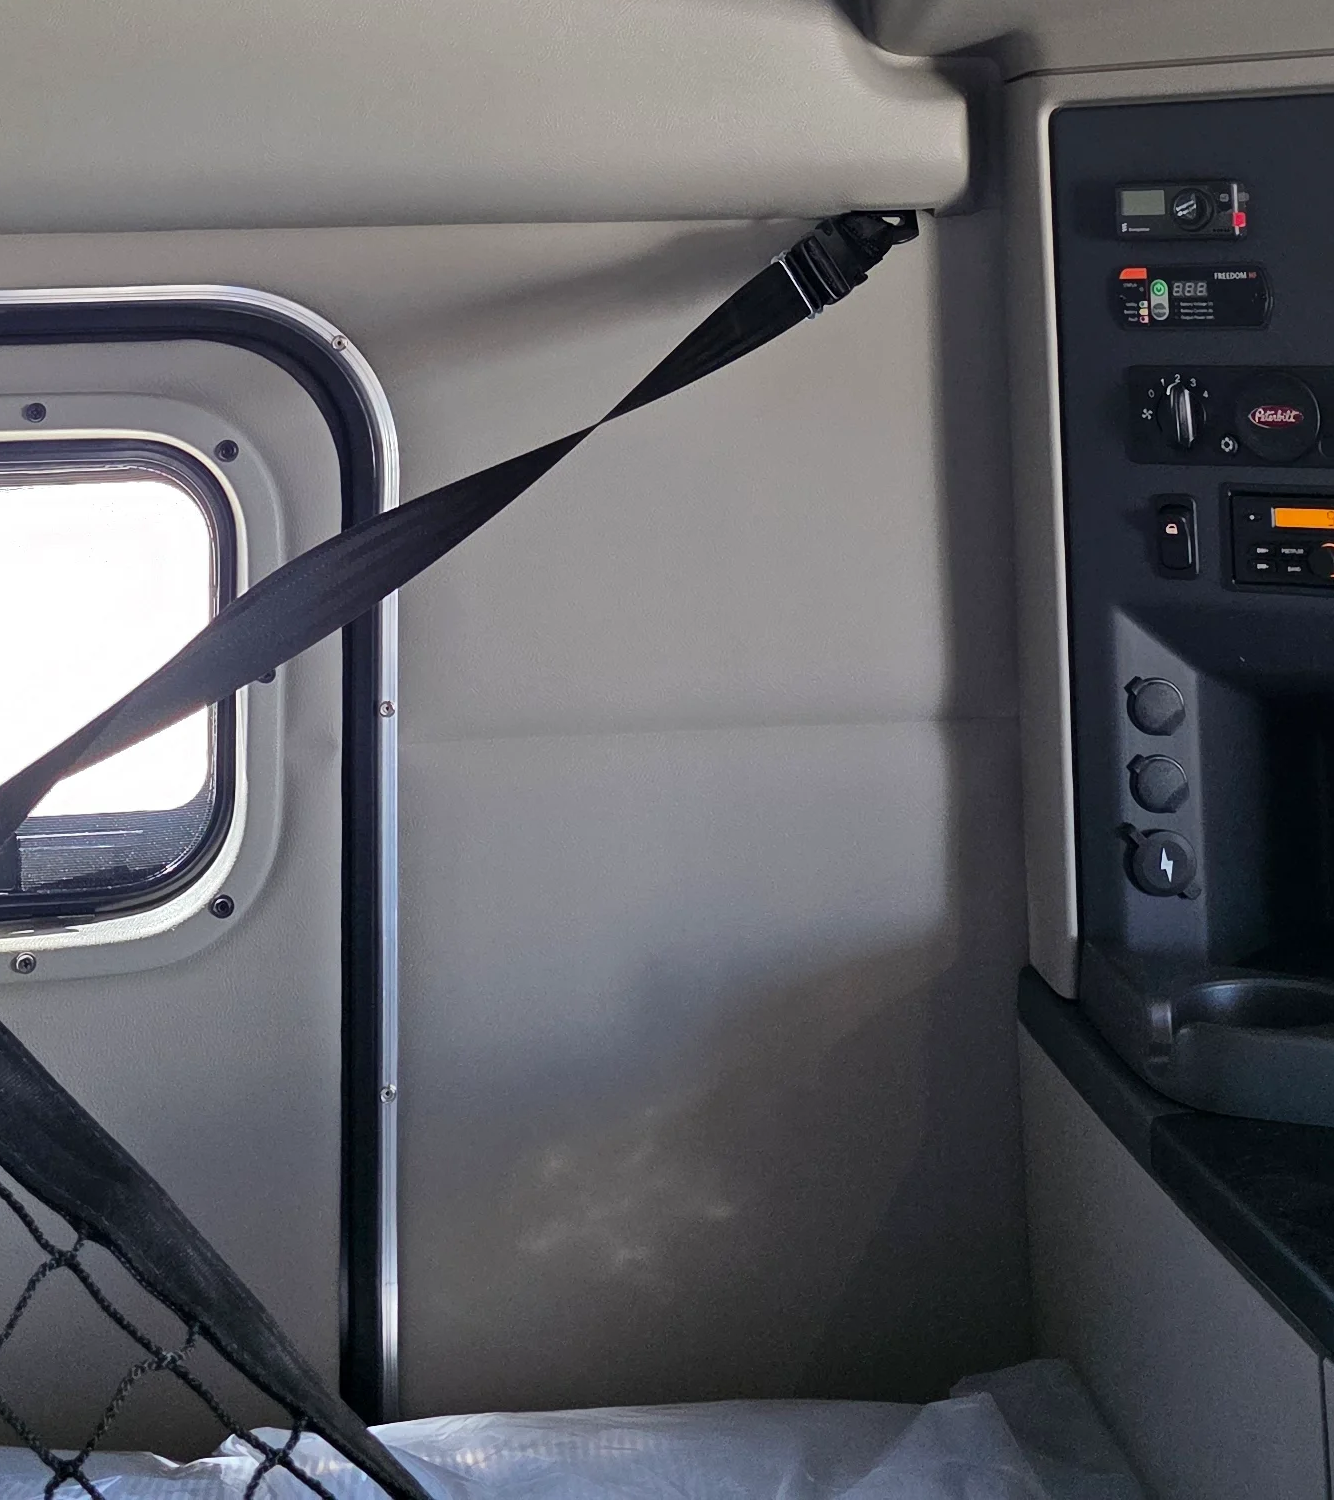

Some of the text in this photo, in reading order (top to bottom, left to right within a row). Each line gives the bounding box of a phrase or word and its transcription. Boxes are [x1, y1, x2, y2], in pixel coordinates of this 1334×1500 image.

[1214, 271, 1247, 280] FREEDOM
[1160, 378, 1165, 387] 1
[1174, 373, 1181, 383] 2
[1190, 378, 1197, 387] 3
[1202, 390, 1209, 398] 4
[1255, 408, 1300, 423] Peterbilt
